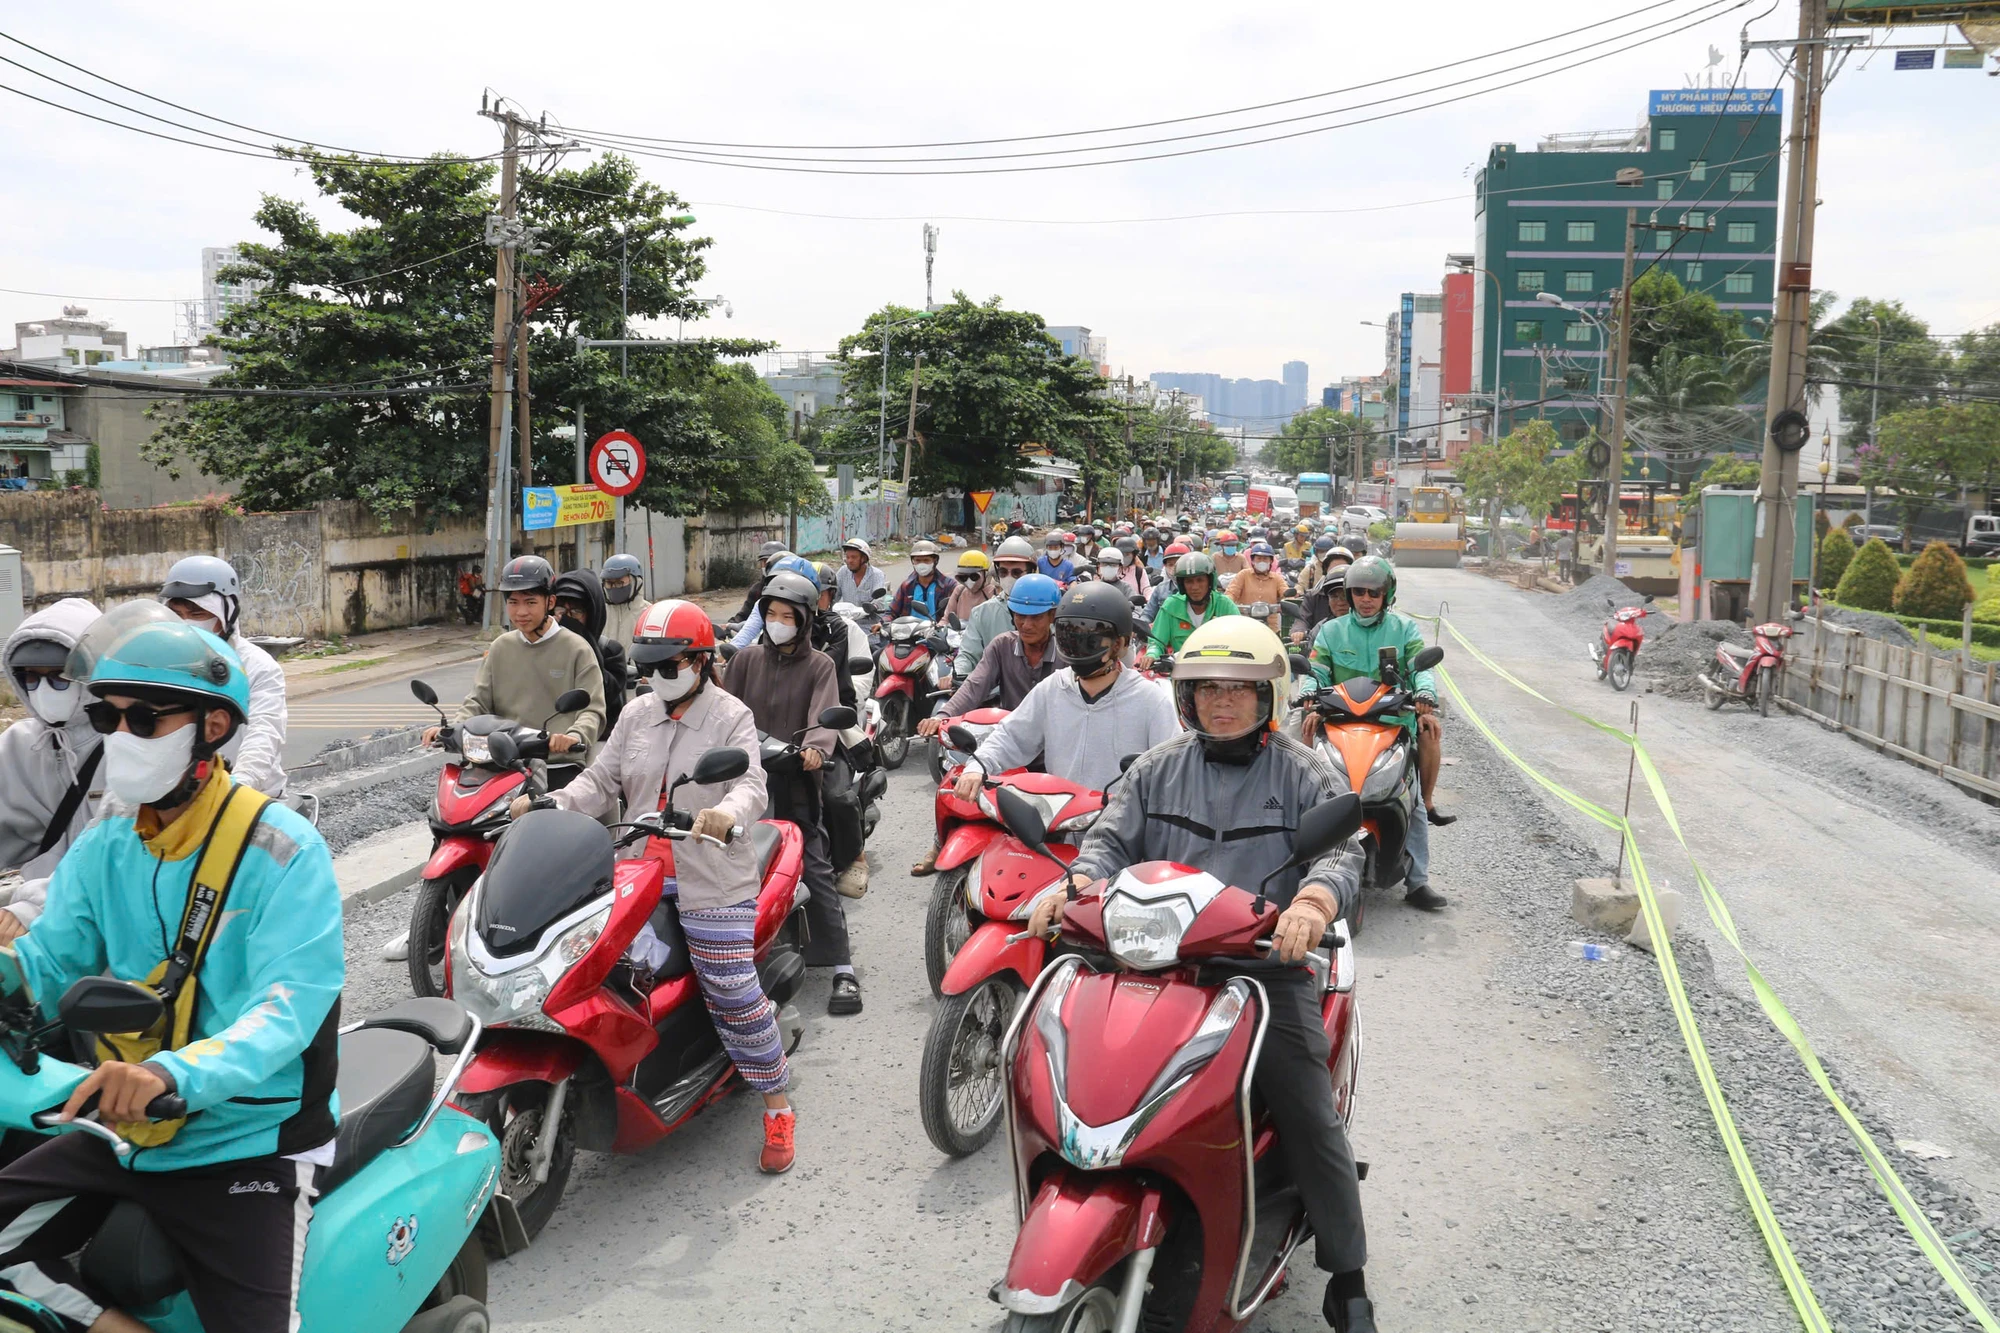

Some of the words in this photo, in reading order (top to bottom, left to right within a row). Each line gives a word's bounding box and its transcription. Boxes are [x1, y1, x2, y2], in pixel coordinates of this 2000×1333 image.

[1726, 100, 1754, 112] QUỐC
[489, 923, 517, 932] HONDA
[1119, 981, 1160, 991] HONDA
